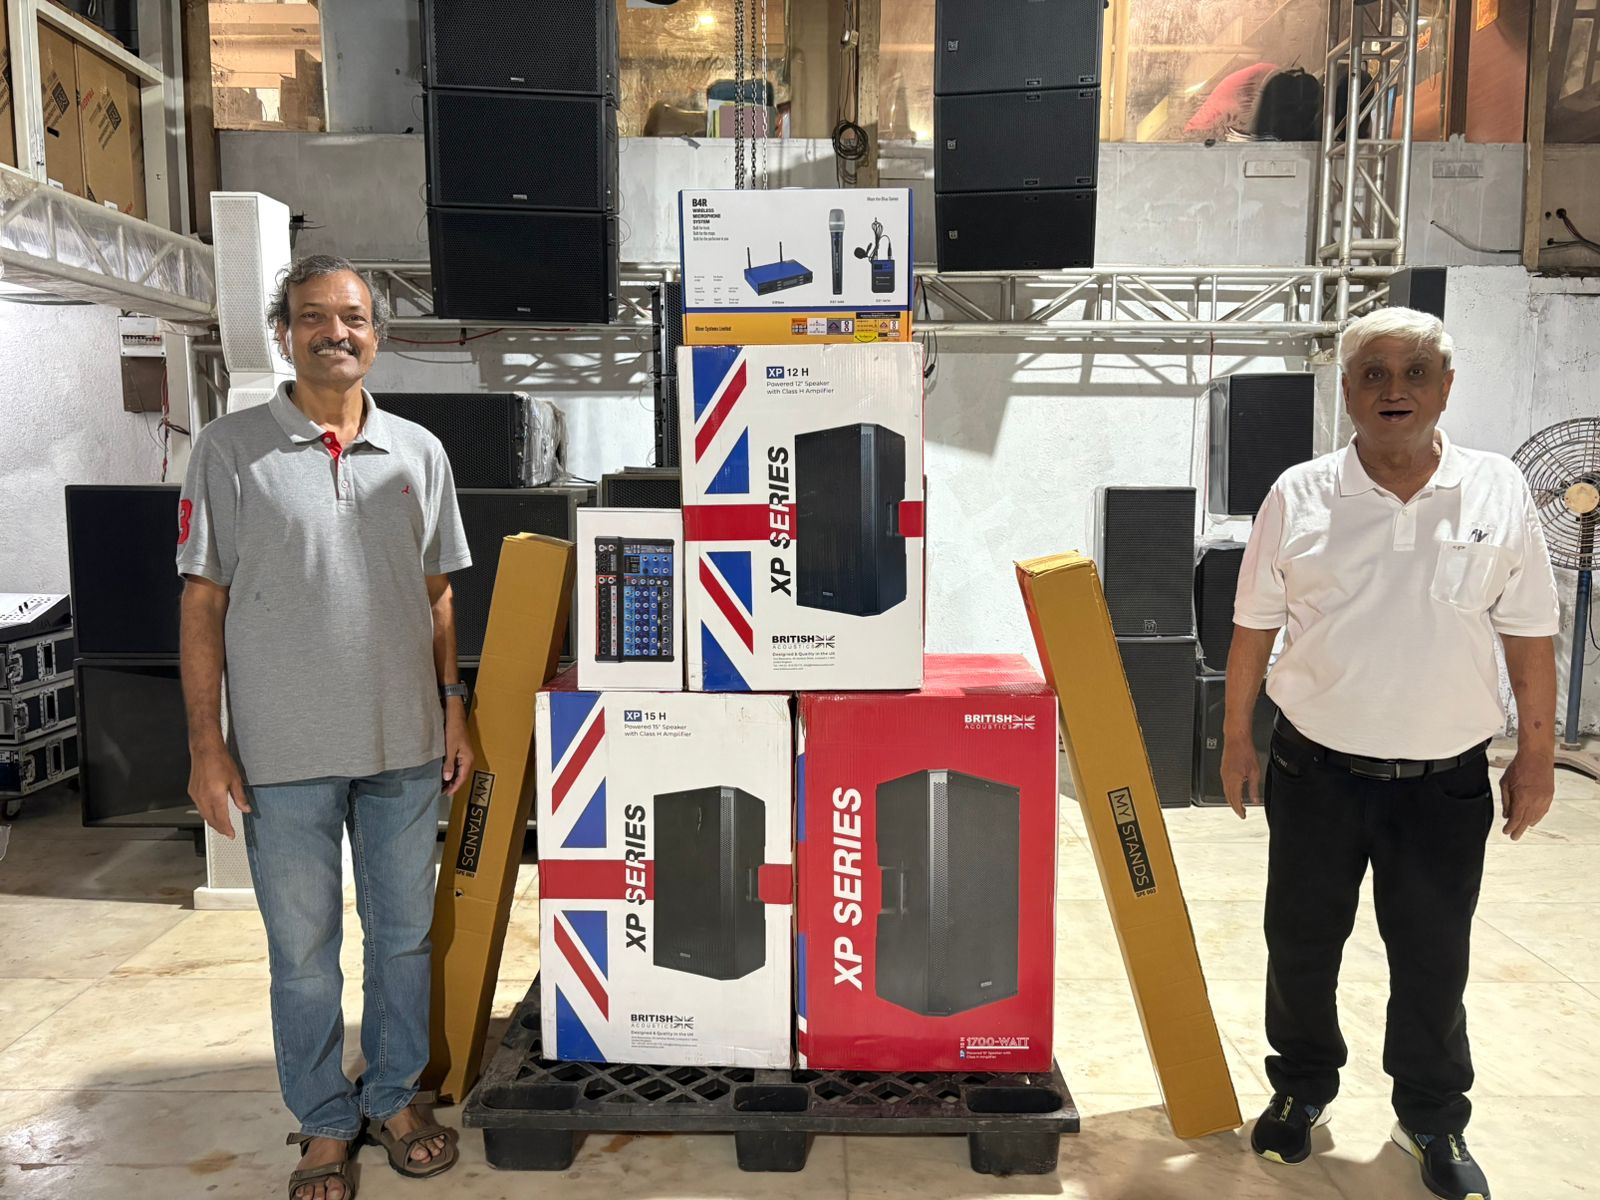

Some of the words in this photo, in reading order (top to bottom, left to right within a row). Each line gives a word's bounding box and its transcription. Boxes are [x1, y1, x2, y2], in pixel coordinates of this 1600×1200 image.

[692, 198, 707, 207] B4R
[768, 368, 783, 377] XP
[786, 367, 799, 377] 12
[801, 367, 809, 377] H
[767, 446, 791, 549] SERIES
[770, 557, 791, 597] XP
[772, 635, 815, 643] BRITISH
[626, 712, 640, 720] XP
[645, 712, 656, 720] 15
[659, 712, 667, 720] H
[964, 714, 1013, 723] BRITISH
[475, 777, 490, 801] MY
[1114, 793, 1131, 817] MY
[462, 807, 483, 866] STANDS
[624, 803, 647, 906] SERIES
[832, 786, 863, 926] SERIES
[1122, 825, 1149, 886] STANDS
[626, 913, 646, 953] XP
[833, 936, 863, 991] XP
[630, 1014, 673, 1023] BRITISH
[966, 1036, 1030, 1047] 1700-WATT
